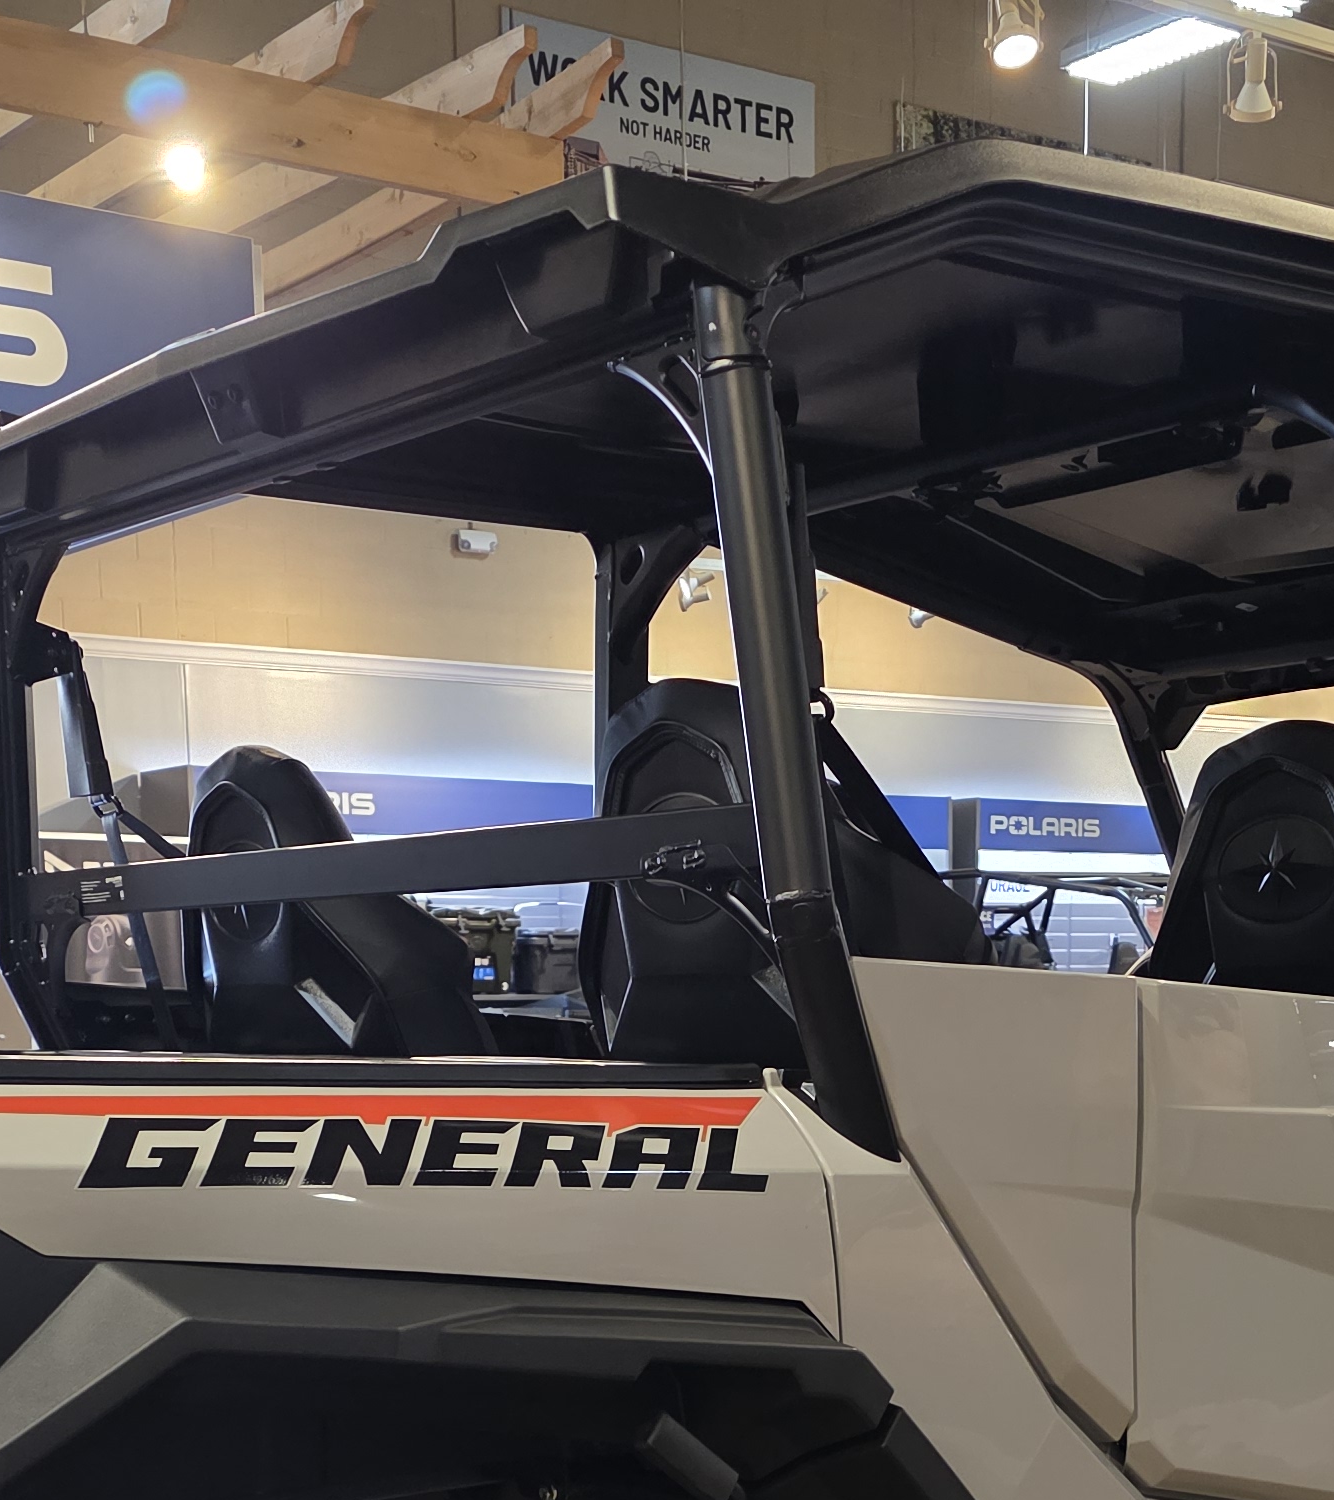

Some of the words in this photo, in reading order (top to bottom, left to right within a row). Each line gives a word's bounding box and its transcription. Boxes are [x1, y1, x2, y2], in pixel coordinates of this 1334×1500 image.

[528, 51, 629, 107] WK
[640, 77, 794, 143] SMARTER
[619, 117, 649, 138] NOT
[654, 125, 710, 152] HARDER
[989, 815, 1101, 837] POLARIS
[77, 1117, 769, 1193] GENERAL
